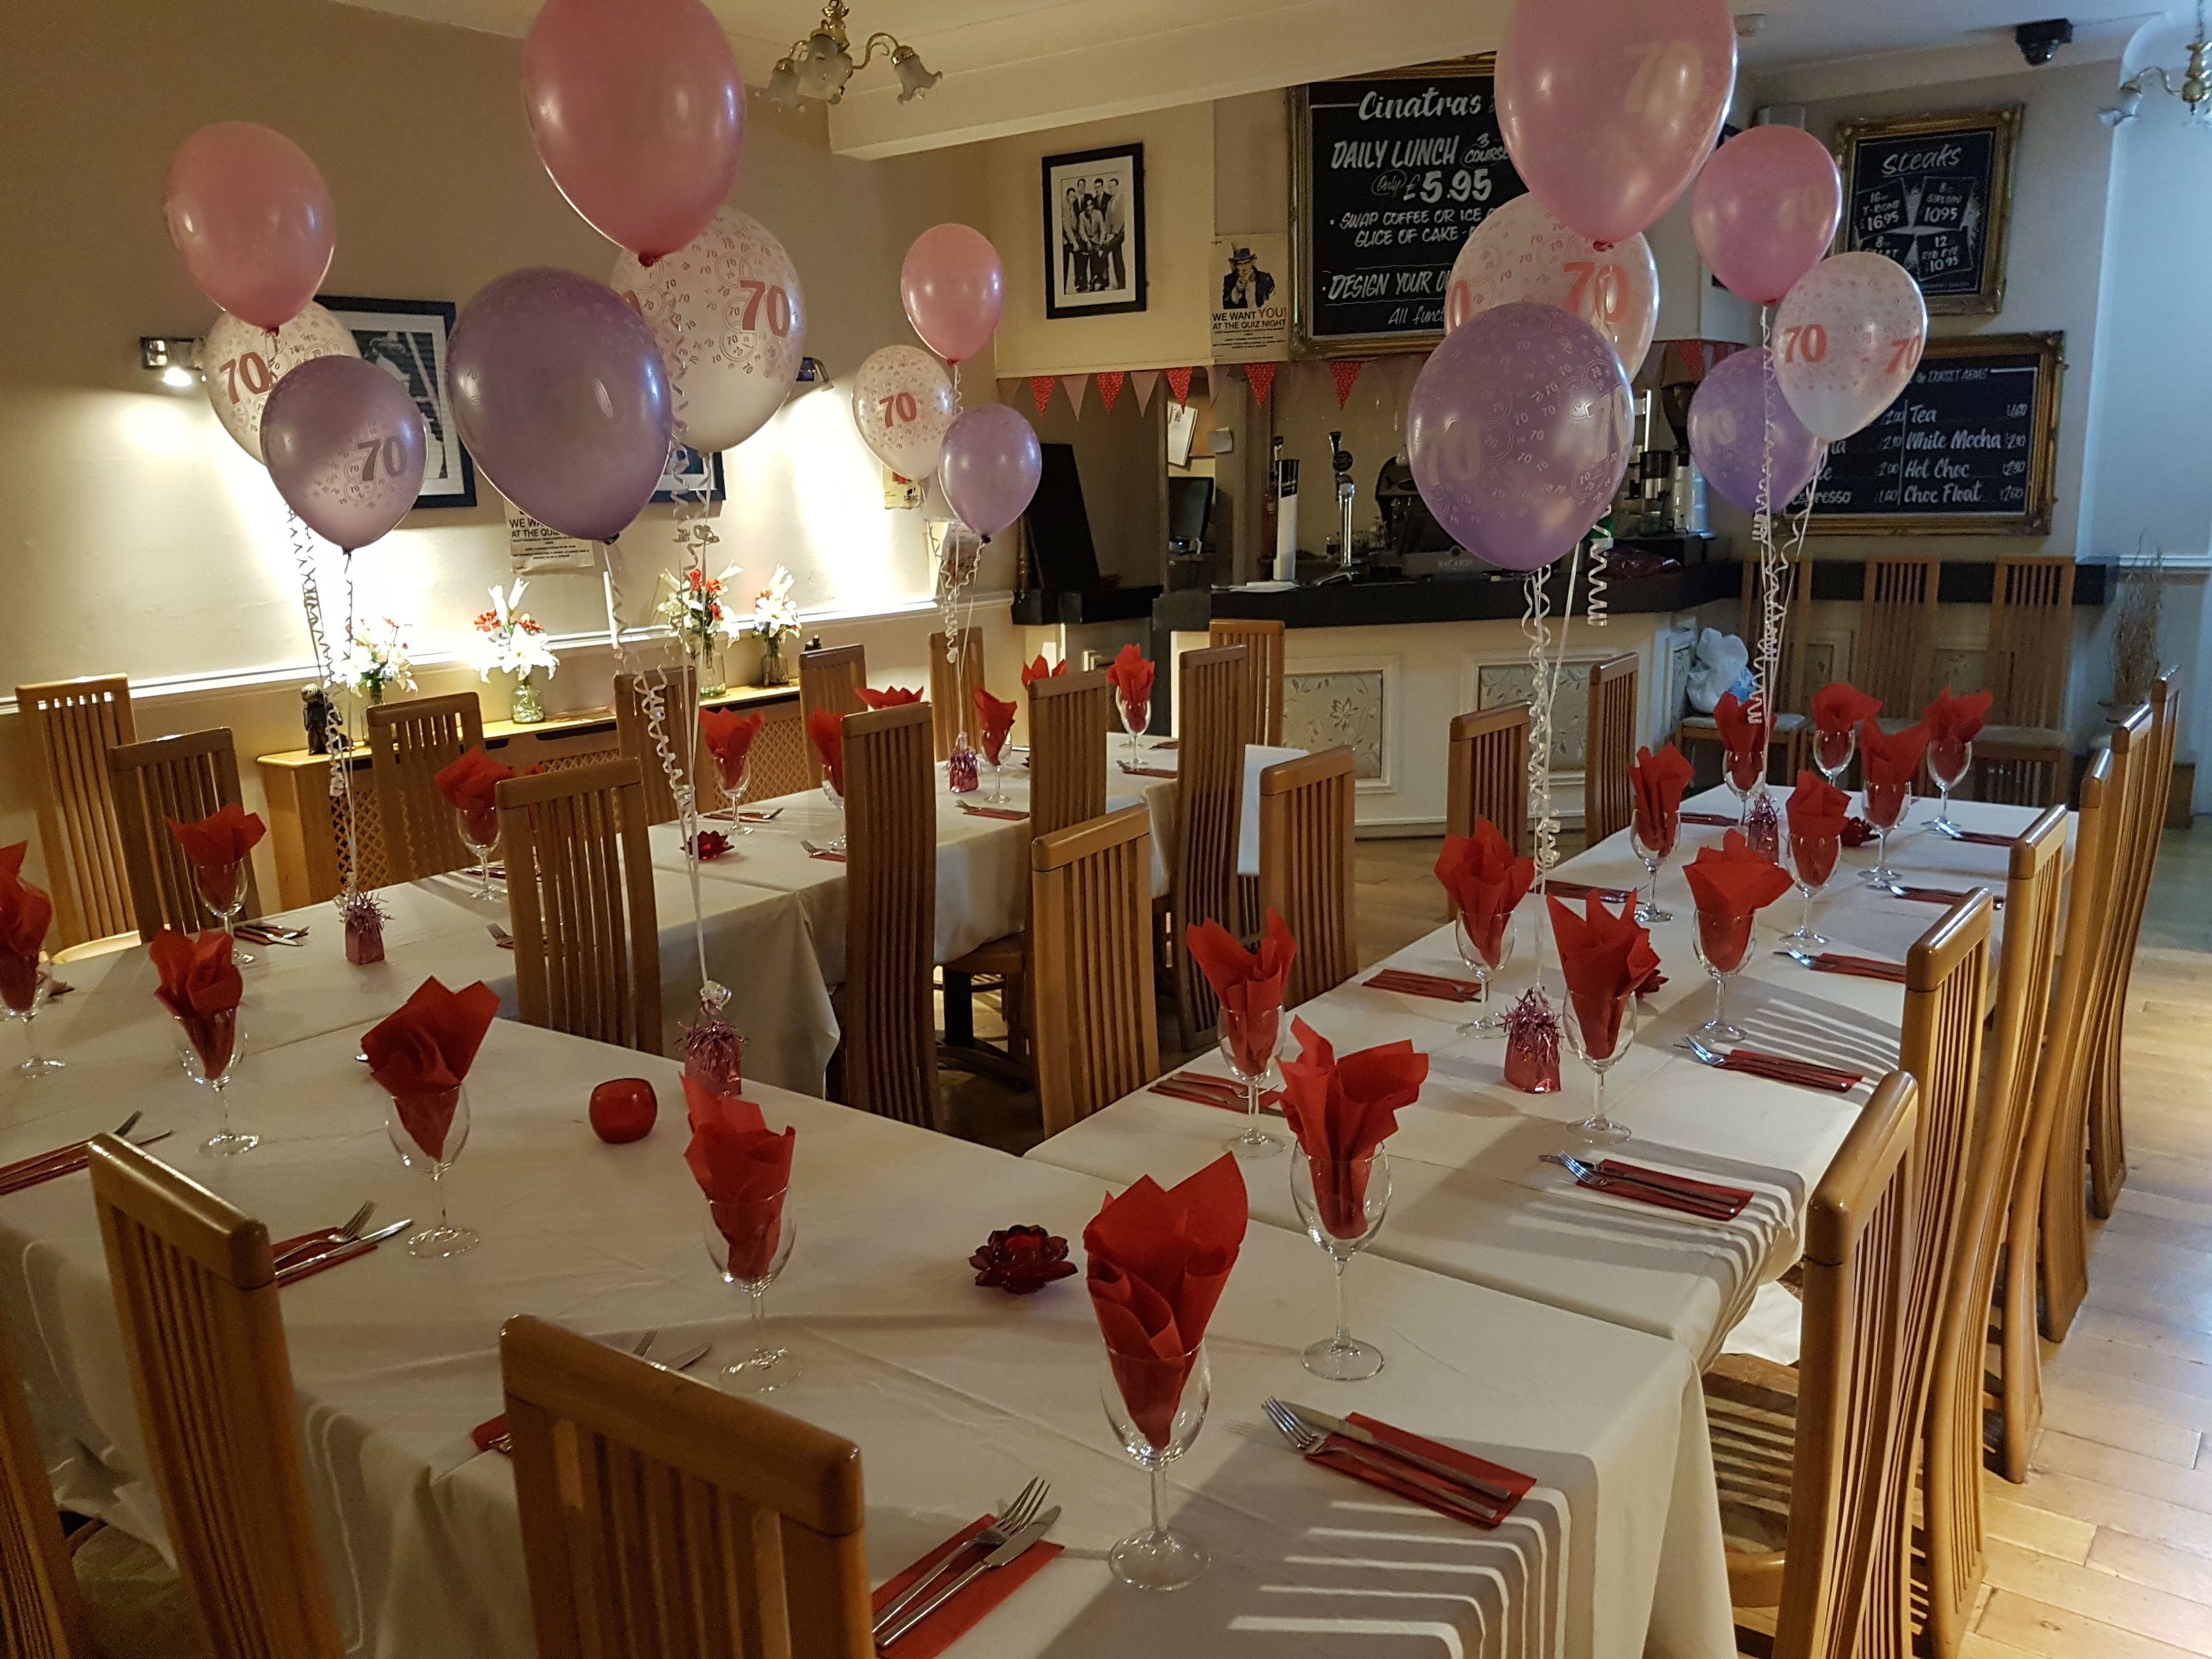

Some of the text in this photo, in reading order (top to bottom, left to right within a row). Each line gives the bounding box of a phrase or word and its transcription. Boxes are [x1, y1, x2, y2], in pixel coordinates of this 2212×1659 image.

[1331, 139, 1388, 169] DAILY
[1391, 135, 1460, 168] LUNCH
[1476, 132, 1491, 148] 3
[1403, 168, 1493, 203] £5.95
[1339, 211, 1379, 229] SWAP
[1382, 210, 1430, 226] COFFEE
[1434, 209, 1456, 224] OR
[1460, 207, 1483, 222] ICE
[1354, 229, 1394, 248] SLICE
[1397, 229, 1419, 244] OF
[1422, 226, 1459, 242] CAKE
[1519, 253, 1532, 264] 70
[1501, 270, 1512, 281] 70
[665, 279, 676, 290] 70
[1328, 273, 1390, 300] DESIGN
[1396, 271, 1433, 295] YOUR
[644, 300, 654, 310] 70
[729, 306, 740, 317] 70
[740, 279, 791, 339] 70
[1213, 306, 1287, 321] WE WANT YOU!
[1388, 307, 1409, 325] All
[1224, 321, 1240, 329] THE
[1241, 320, 1261, 329] QUIZ
[1262, 319, 1286, 327] NIGHT
[727, 335, 738, 346] 70
[1783, 324, 1828, 365] 70
[712, 354, 722, 364] 70
[1885, 335, 1921, 375] 70
[219, 351, 273, 406] 70
[1545, 382, 1559, 395] 70
[879, 392, 917, 429] 70
[1543, 404, 1556, 417] 70
[1910, 404, 1938, 423] Tea
[1514, 412, 1529, 426] 70
[1529, 430, 1544, 441] 70
[1906, 431, 1946, 450] White
[1950, 427, 2002, 450] Mocha
[357, 436, 407, 482] 70
[1517, 453, 1533, 463] 70
[350, 465, 359, 473] 70
[1905, 457, 1930, 478] Hot
[1904, 484, 1940, 503] Choc
[1942, 479, 1983, 503] Float
[510, 518, 525, 528] WE
[512, 530, 521, 538] AT
[522, 528, 539, 538] THE
